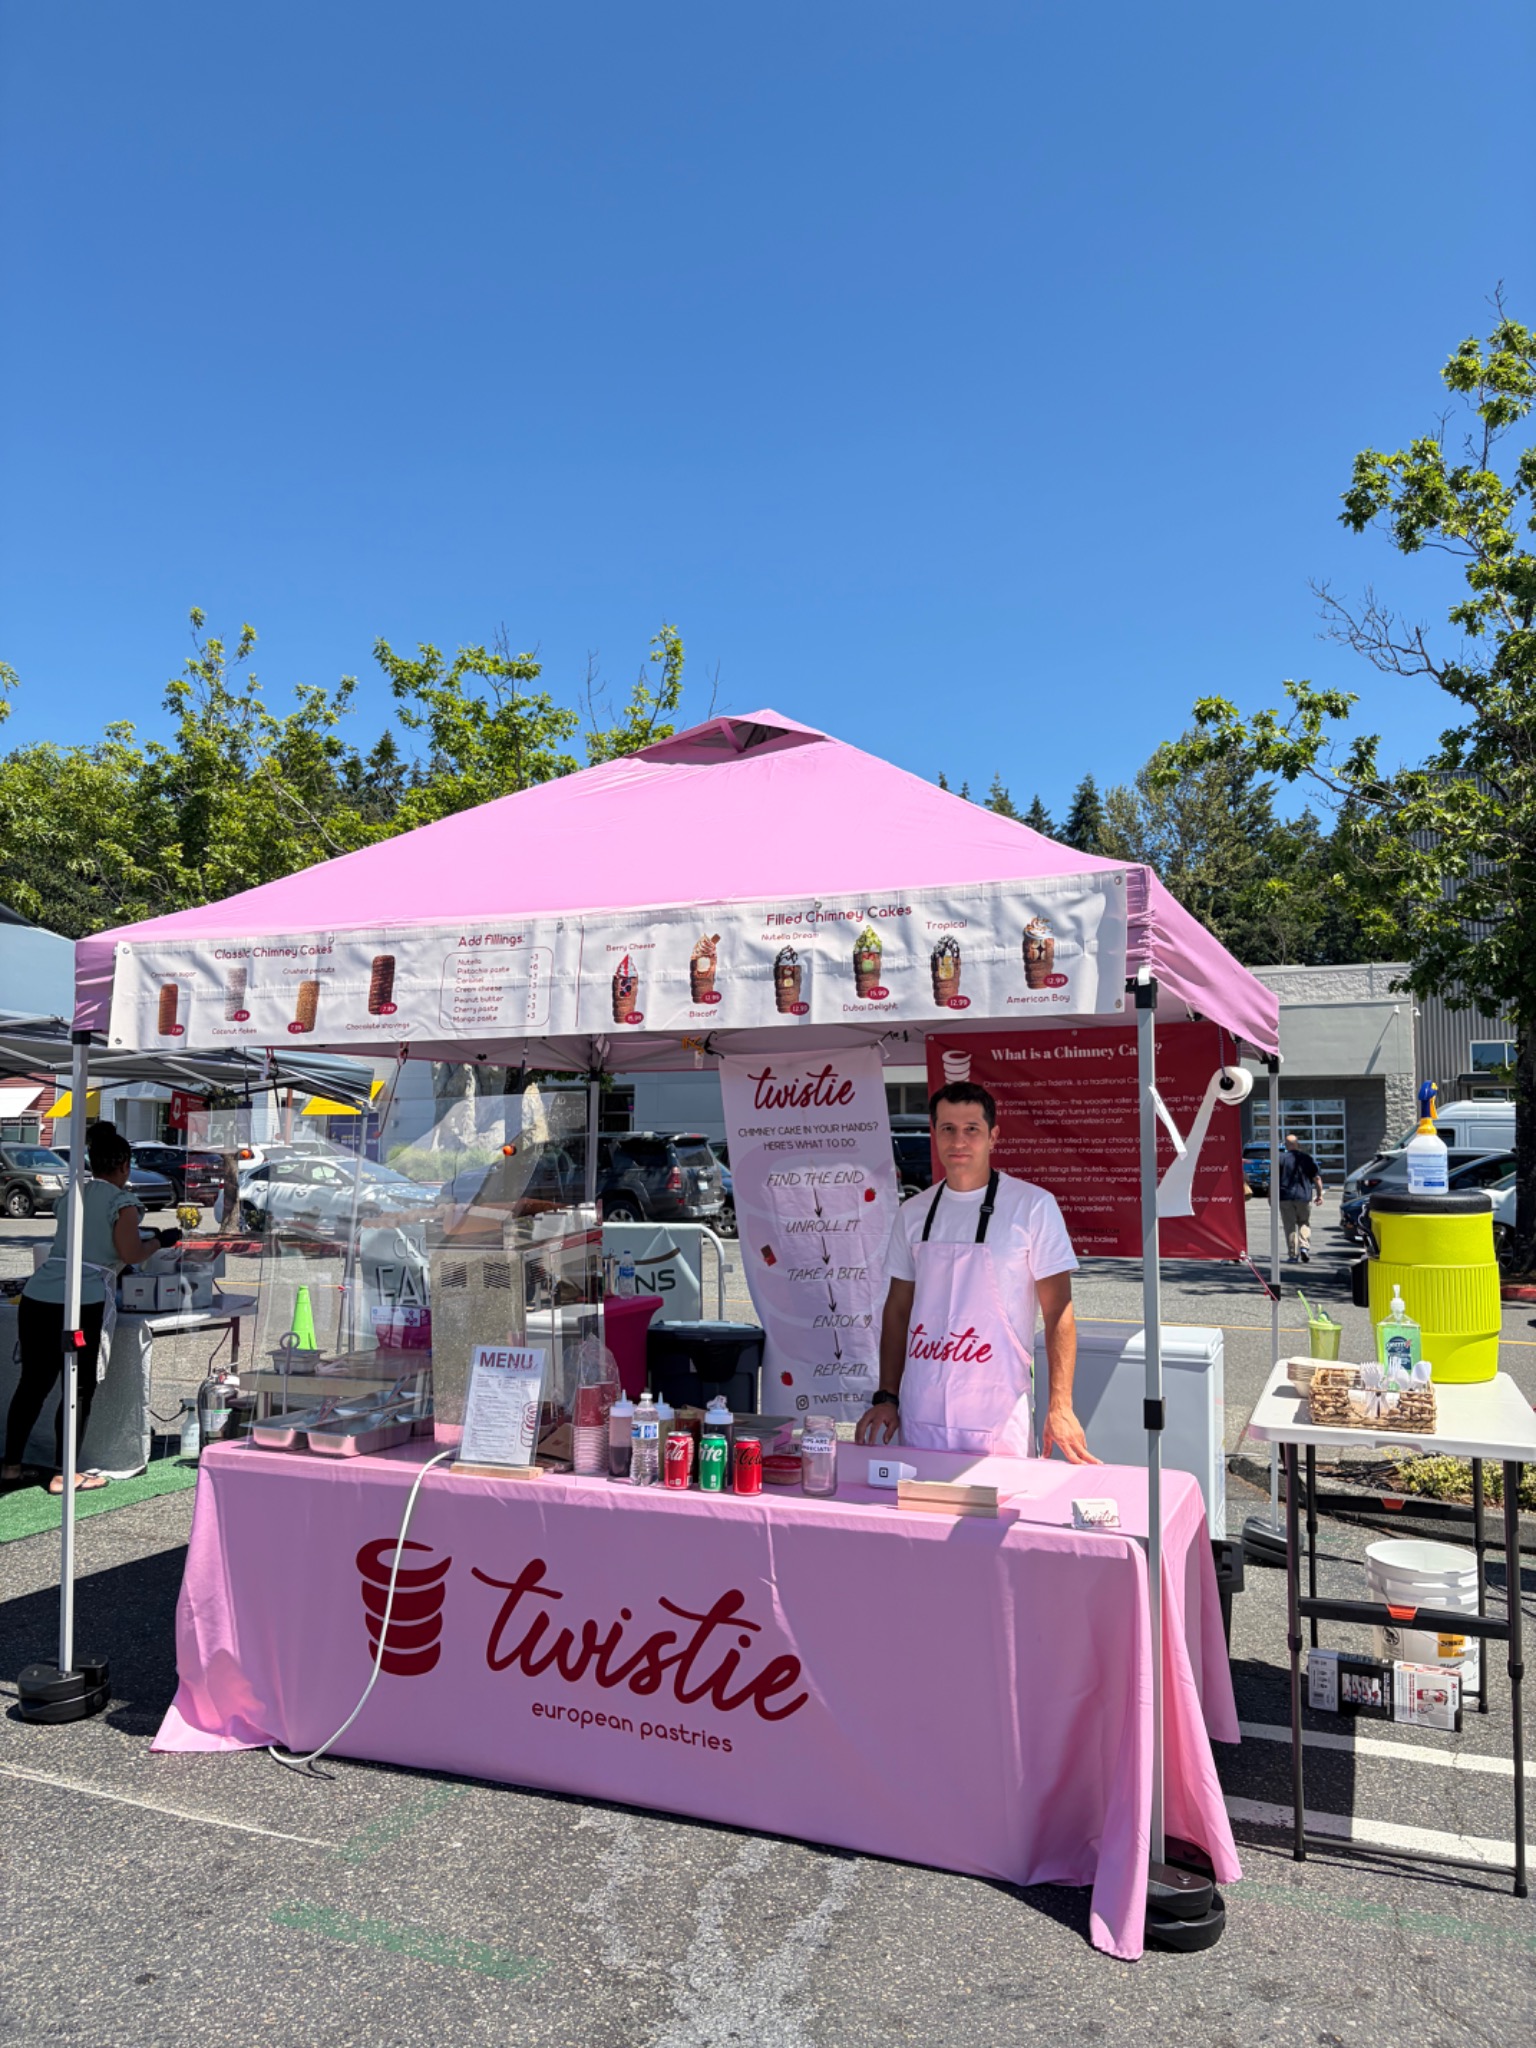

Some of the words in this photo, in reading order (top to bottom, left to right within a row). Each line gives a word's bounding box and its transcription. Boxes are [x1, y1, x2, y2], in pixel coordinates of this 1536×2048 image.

[766, 912, 802, 926] Filled
[805, 908, 863, 923] Chimney
[867, 905, 912, 919] Cakes
[926, 919, 968, 932] Tropical
[458, 935, 482, 948] Add
[761, 933, 791, 941] Nutella
[793, 932, 819, 940] Dream
[214, 947, 251, 960] Classic
[252, 946, 298, 960] Chimney
[300, 944, 333, 956] Cakes
[606, 943, 628, 952] Berry
[629, 942, 656, 950] Cheese
[457, 958, 482, 966] Nutella
[309, 966, 336, 975] peanuts
[457, 967, 488, 975] Pistachio
[489, 966, 510, 975] paste
[1047, 977, 1065, 985] 12.99
[480, 995, 504, 1003] butter
[950, 998, 968, 1007] 12.99
[1007, 995, 1050, 1005] American
[1052, 993, 1070, 1004] Boy
[453, 1006, 477, 1014] Cherry
[477, 1005, 498, 1013] paste
[689, 1009, 718, 1018] Biscoff
[843, 1003, 866, 1012] Dubai
[867, 1002, 899, 1013] Delight
[452, 1015, 475, 1023] Mango
[212, 1027, 237, 1035] Coconut
[238, 1027, 257, 1035] flakes
[346, 1023, 380, 1031] Chocolate
[381, 1021, 410, 1031] shavings
[991, 1048, 1027, 1061] What
[1030, 1047, 1041, 1059] is
[1043, 1049, 1051, 1059] a
[1053, 1045, 1116, 1060] Chimney
[1118, 1042, 1163, 1057] Ca?
[747, 1064, 856, 1110] twistie
[738, 1127, 776, 1138] CHIMNEY
[777, 1126, 801, 1136] CAKE
[802, 1125, 812, 1134] IN
[812, 1123, 840, 1134] YOUR
[841, 1121, 879, 1133] HANDS?
[795, 1139, 823, 1149] WHAT
[826, 1138, 840, 1148] TO
[767, 1172, 801, 1187] FIND
[803, 1171, 832, 1185] THE
[833, 1170, 864, 1184] END
[785, 1220, 842, 1233] UNROLL
[844, 1219, 861, 1232] IT
[787, 1268, 821, 1281] TAKE
[823, 1268, 834, 1279] A
[836, 1267, 868, 1280] BITE
[812, 1314, 860, 1329] ENJOY
[908, 1323, 993, 1363] twistie
[480, 1351, 533, 1369] MENU
[813, 1363, 868, 1377] REPEAT!
[471, 1558, 809, 1722] twistie
[531, 1702, 634, 1733] european
[639, 1719, 733, 1753] pastries
